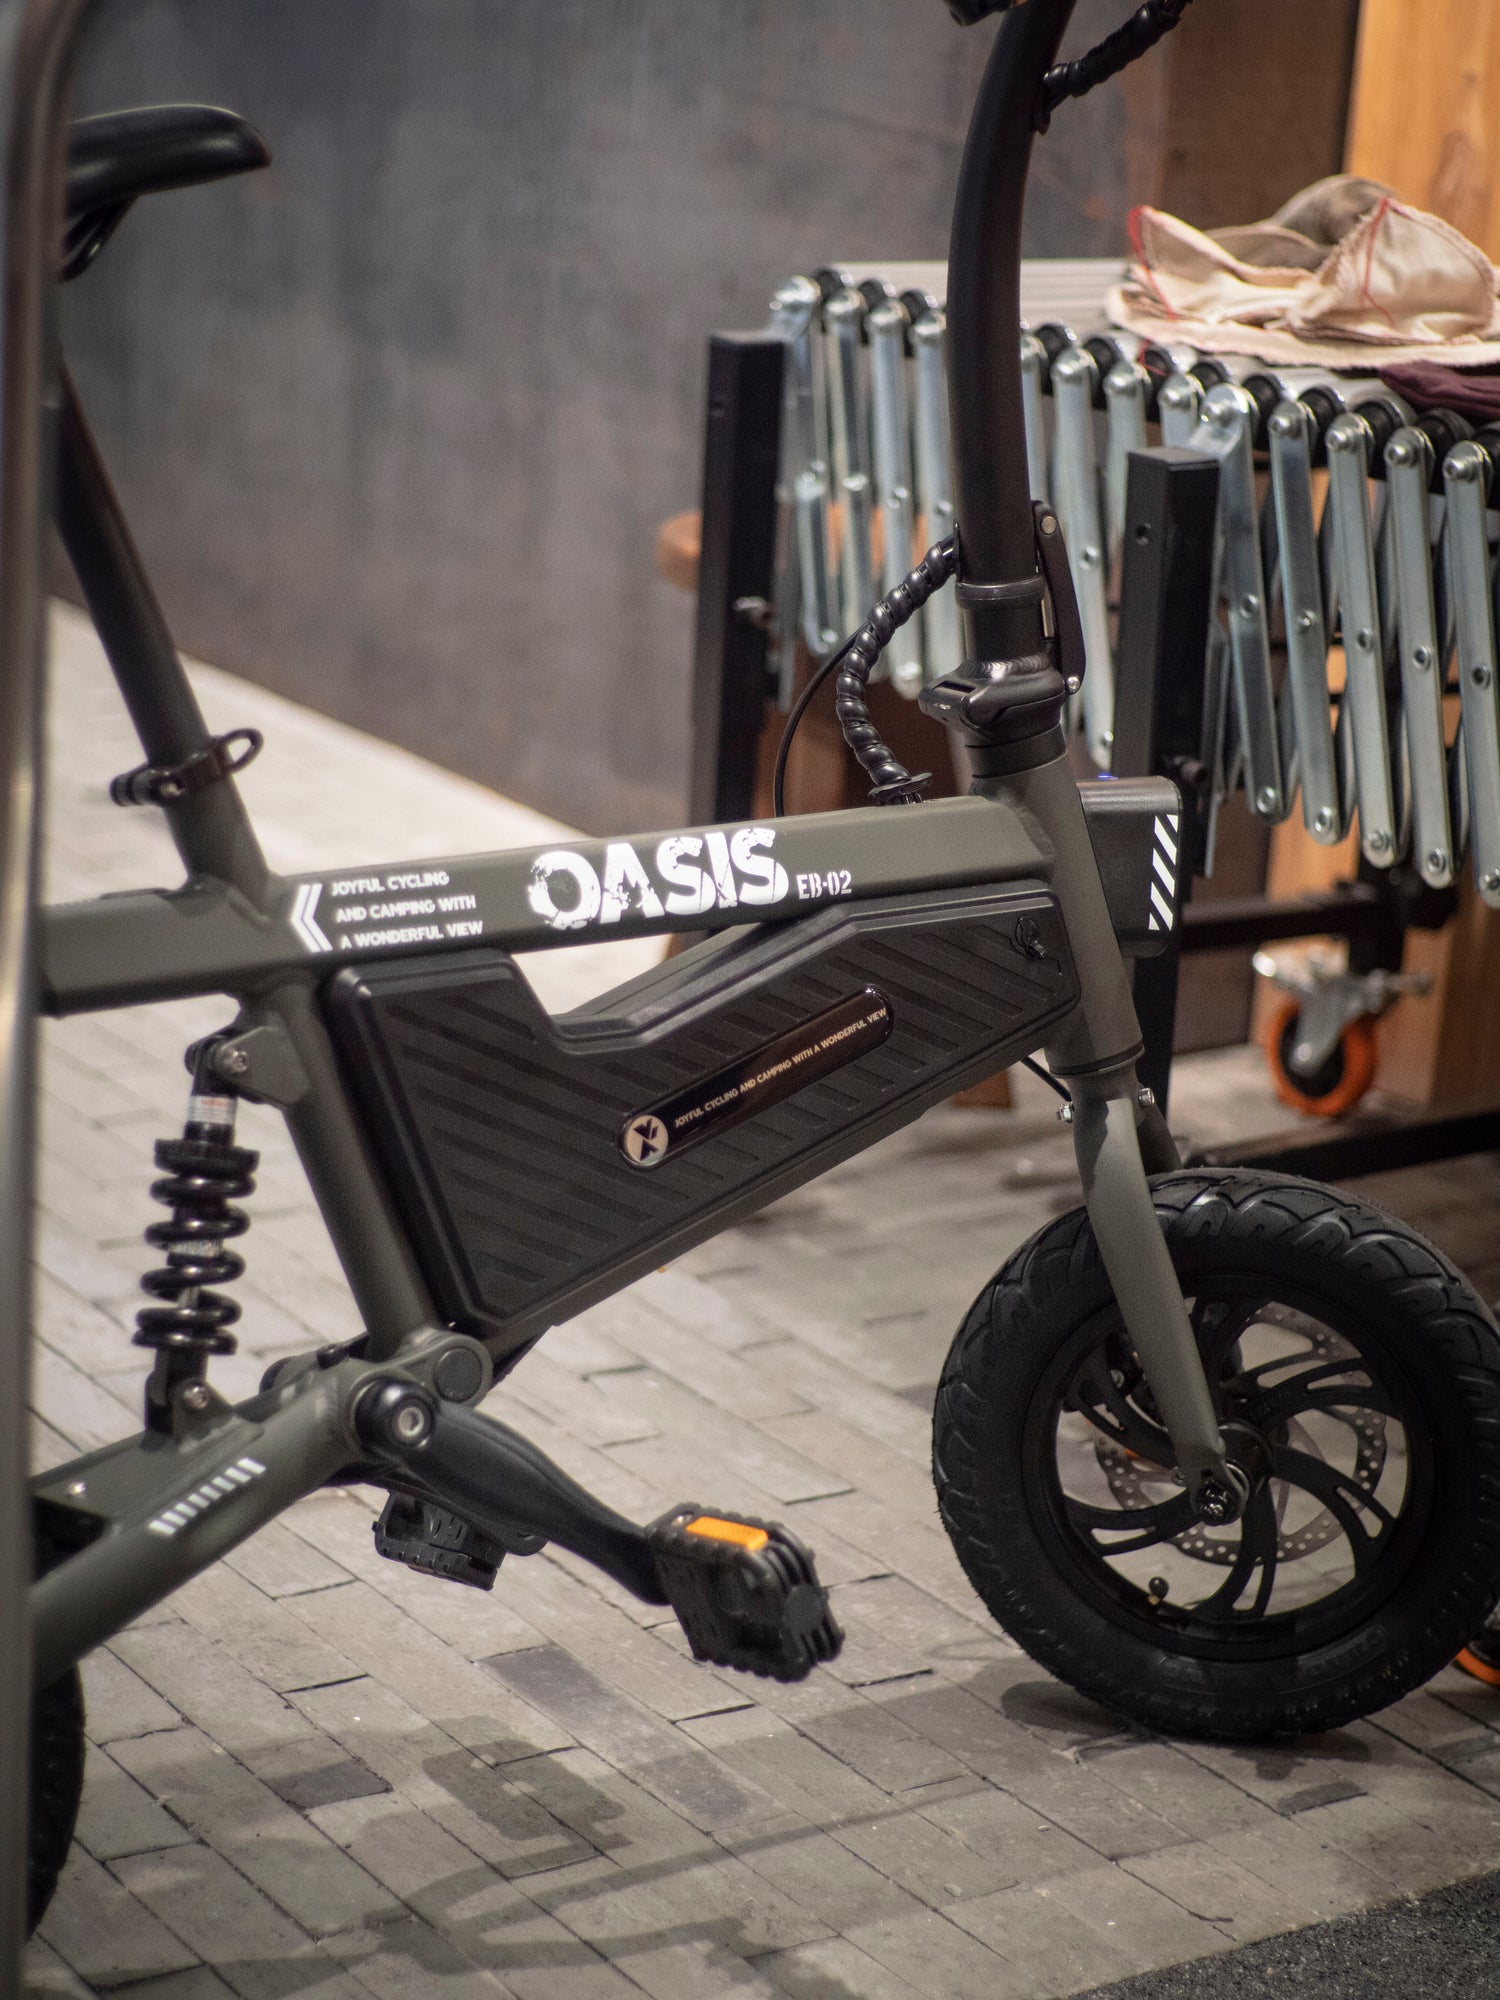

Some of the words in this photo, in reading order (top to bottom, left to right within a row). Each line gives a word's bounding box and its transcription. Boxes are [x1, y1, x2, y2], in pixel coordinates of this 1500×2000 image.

[332, 878, 386, 897] JOYFUL
[387, 871, 450, 891] CYCLING
[528, 828, 790, 931] OASIS
[796, 870, 853, 900] EB-02
[335, 906, 367, 923] AND
[369, 899, 436, 919] CAMPING
[437, 894, 477, 912] WITH
[340, 935, 353, 949] A
[354, 925, 445, 947] WONDERFUL
[446, 920, 484, 937] VIEW
[674, 1107, 705, 1128] JOYFUL
[704, 1088, 739, 1111] CYCLING
[740, 1078, 757, 1093] AND
[756, 1059, 792, 1083] CAMPING
[792, 1047, 813, 1065] WITH
[813, 1043, 821, 1054] A
[820, 1019, 868, 1049] WONDERFUL
[866, 1007, 887, 1023] VIEW
